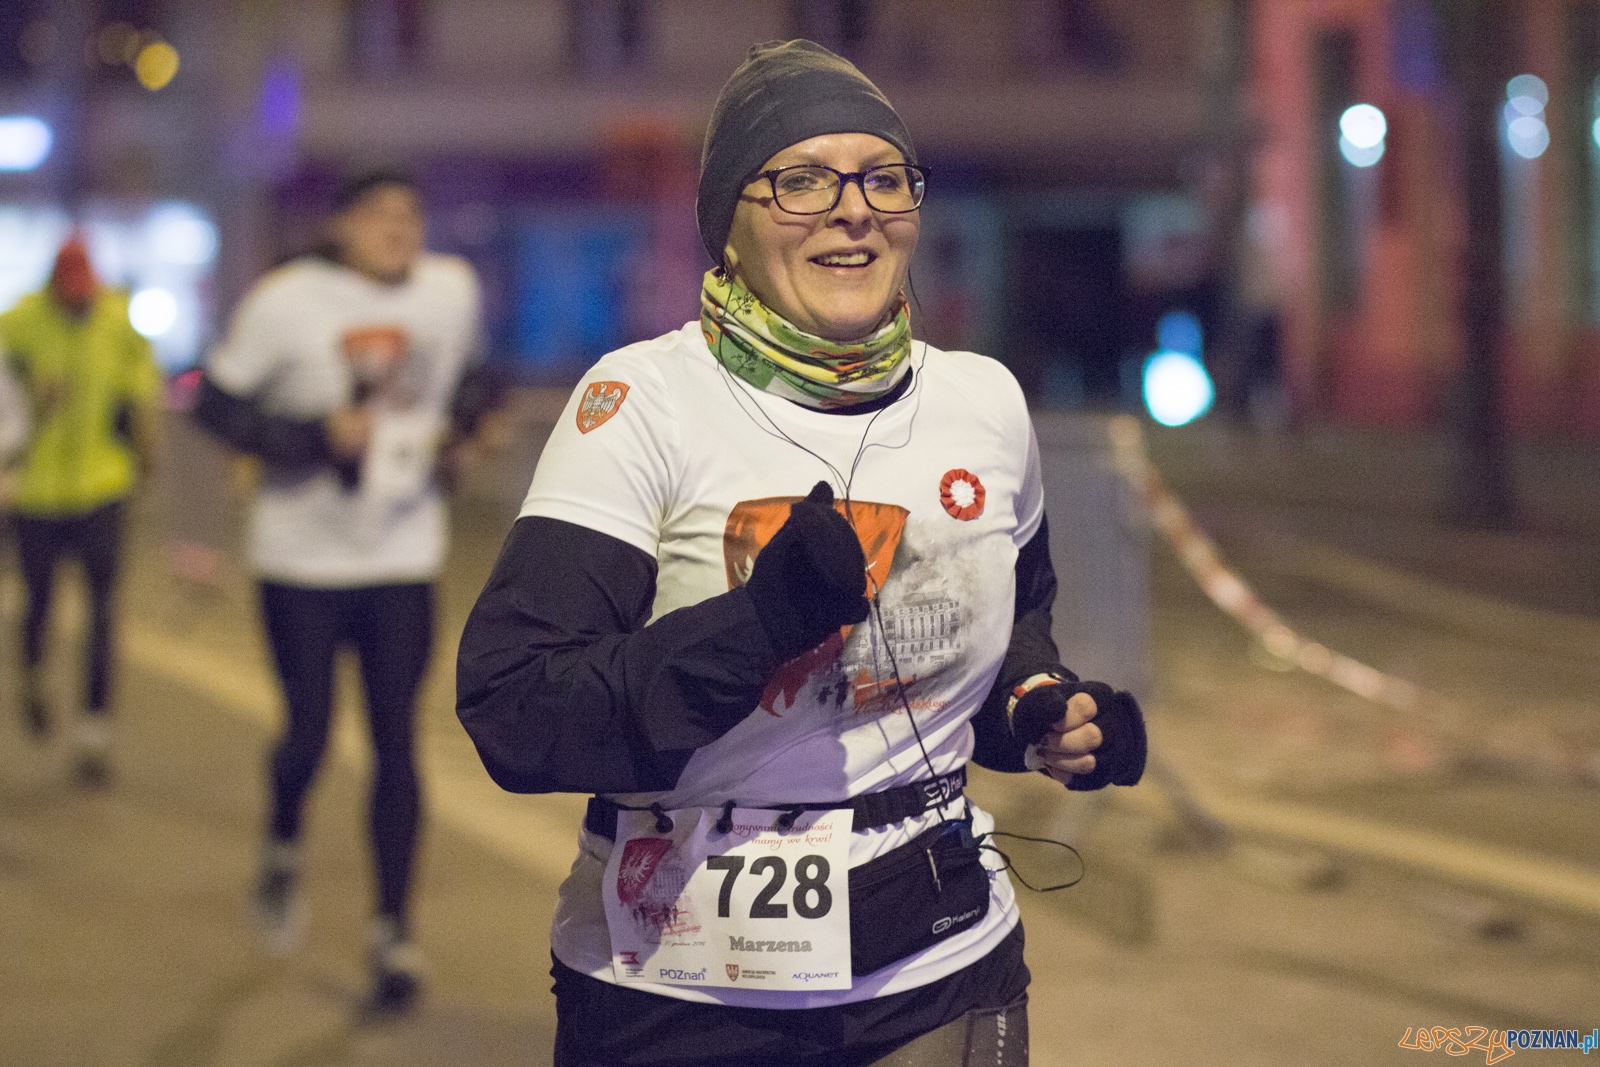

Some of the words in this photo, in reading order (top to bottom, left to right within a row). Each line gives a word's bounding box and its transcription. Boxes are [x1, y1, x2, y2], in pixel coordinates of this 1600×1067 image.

[788, 822, 833, 833] rudności
[751, 837, 783, 851] mamy
[805, 832, 833, 847] krwi!
[706, 854, 833, 919] 728
[728, 934, 813, 953] Marzena
[792, 972, 839, 982] AQUANET
